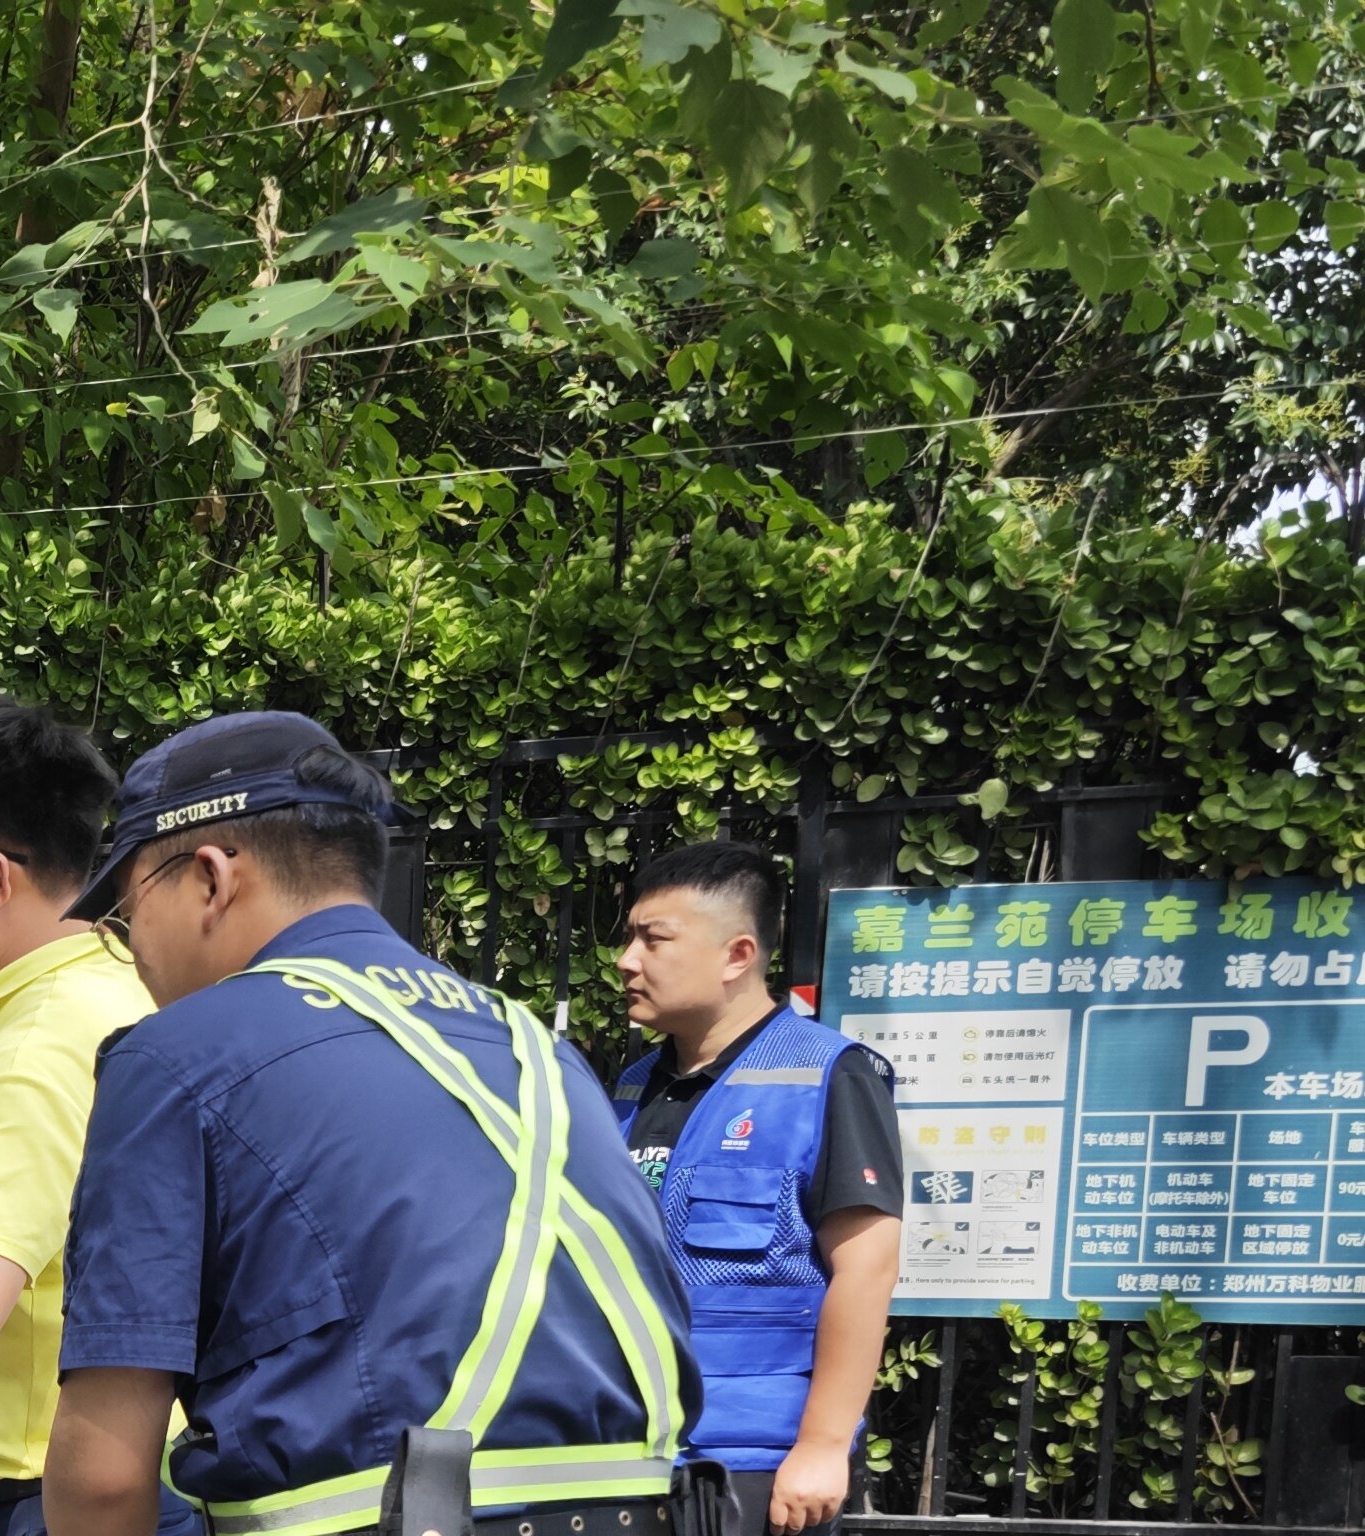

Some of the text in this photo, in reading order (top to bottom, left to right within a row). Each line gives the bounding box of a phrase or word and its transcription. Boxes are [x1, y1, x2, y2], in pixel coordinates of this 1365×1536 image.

[156, 792, 248, 832] SECURITY
[852, 891, 1353, 953] 嘉兰苑停车场收
[849, 950, 1365, 999] 请按提示自觉停放 请勿占
[1185, 1015, 1271, 1107] P
[1083, 1132, 1145, 1147] 车位类型
[1268, 1130, 1302, 1146] 场地
[1085, 1173, 1136, 1188] 地下机
[1167, 1172, 1214, 1187] 机动车
[1248, 1173, 1316, 1188] 地下固定
[1084, 1191, 1135, 1205] 动车位
[1263, 1190, 1297, 1205] 车位
[1076, 1224, 1138, 1238] 地下非机
[1244, 1224, 1311, 1239] 地下固定
[1082, 1241, 1129, 1255] 动车位
